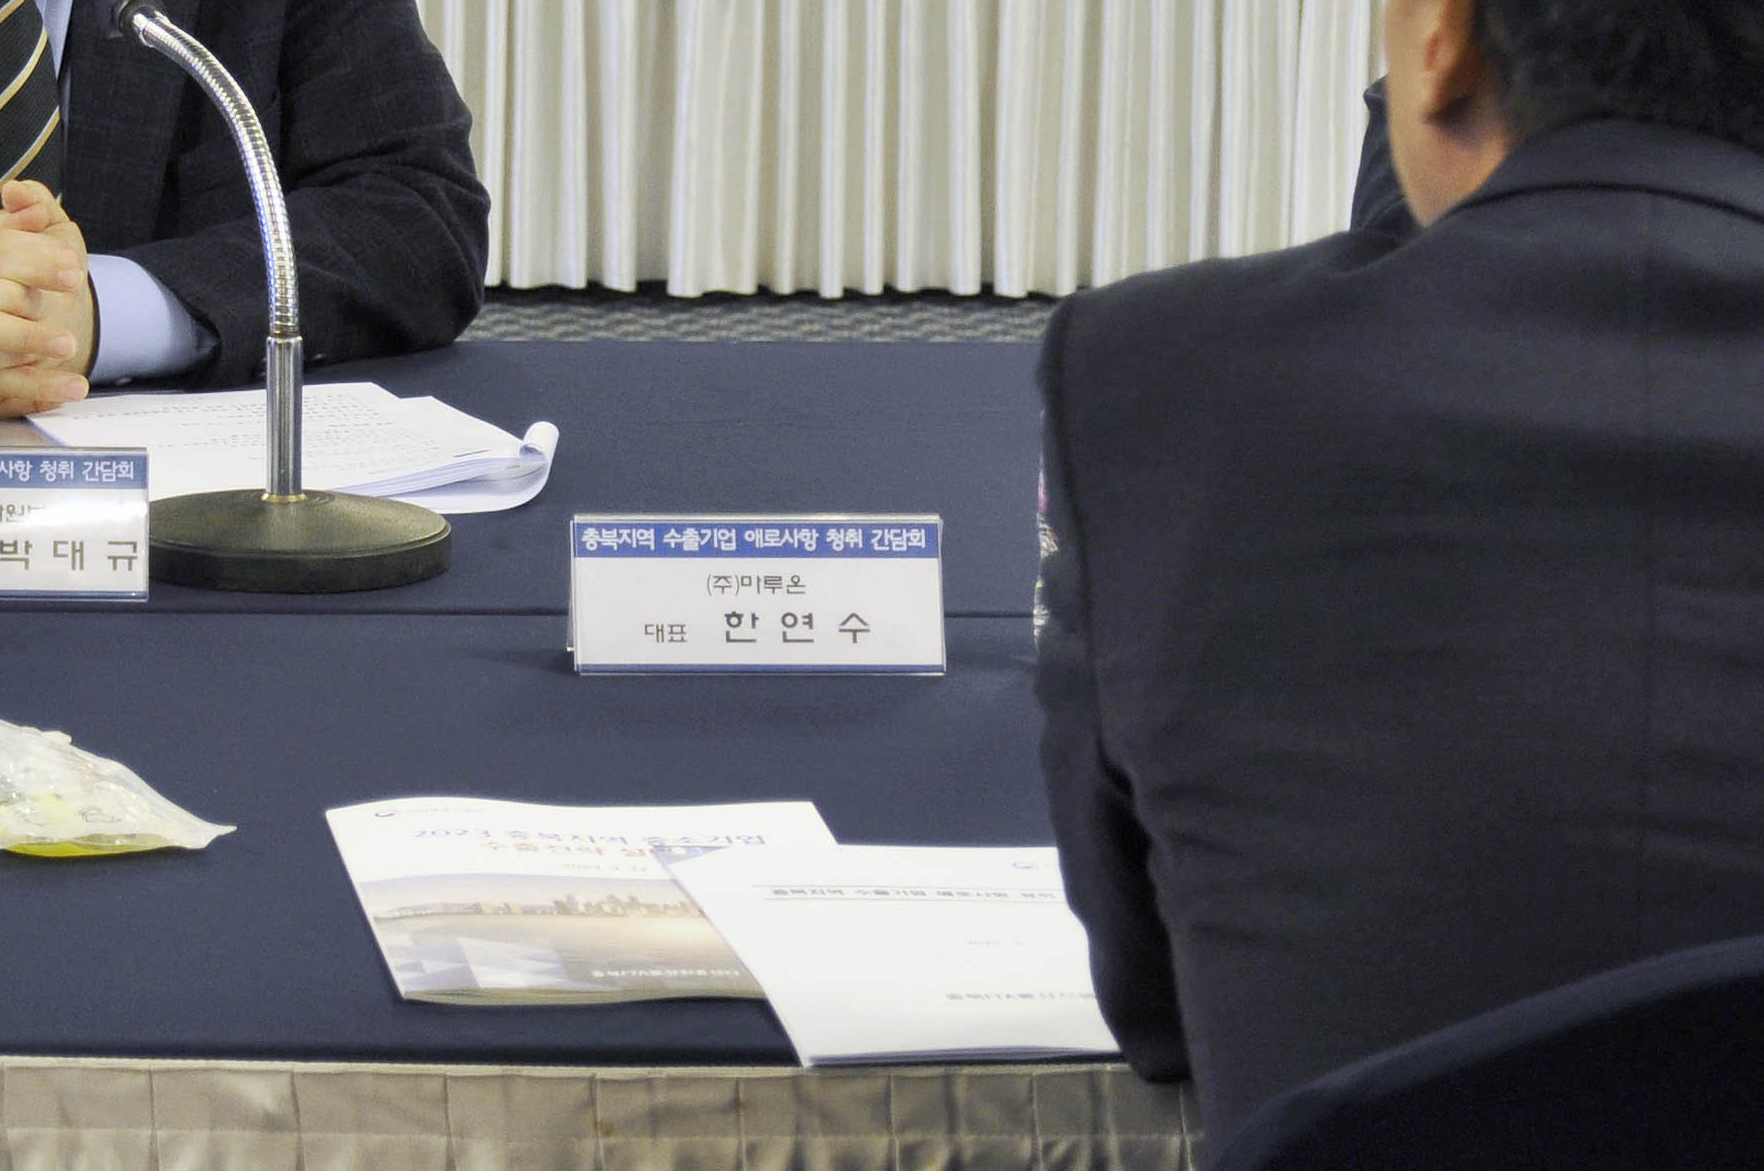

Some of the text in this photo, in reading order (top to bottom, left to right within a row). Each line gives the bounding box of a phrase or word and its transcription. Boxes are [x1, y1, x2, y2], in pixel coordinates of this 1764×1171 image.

[39, 458, 74, 481] 청취
[82, 459, 134, 482] 간담회
[580, 527, 926, 552] 충북지역 수출기업 애로사항 청취 간담회
[706, 573, 807, 596] (주)마루온
[644, 623, 688, 644] 대표
